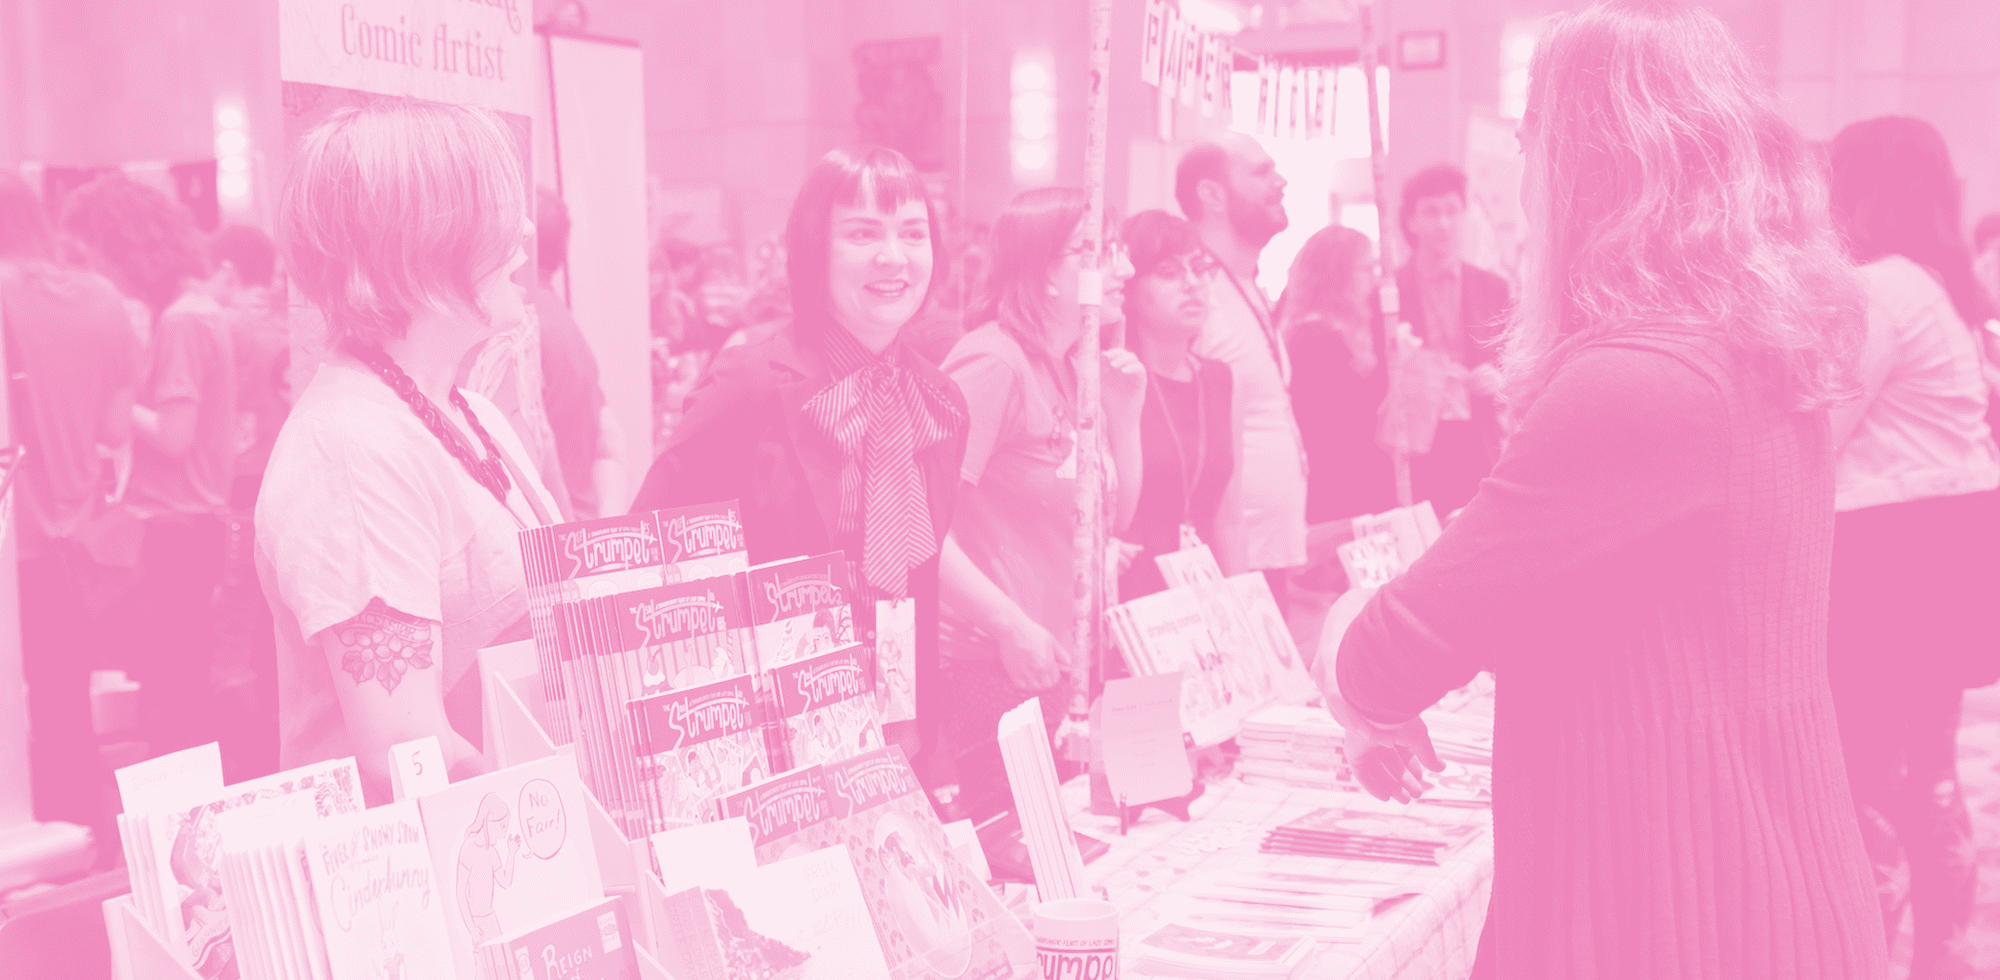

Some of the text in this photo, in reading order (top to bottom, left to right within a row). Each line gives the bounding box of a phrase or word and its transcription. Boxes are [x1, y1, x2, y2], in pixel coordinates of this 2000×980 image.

[341, 2, 421, 68] Comic
[432, 23, 504, 82] Artist
[1145, 12, 1231, 109] PAPER
[564, 520, 651, 580] Strumpet
[667, 508, 738, 564] Strumpet
[635, 589, 715, 648] Strumpet
[765, 564, 835, 623] Strumpet
[797, 653, 859, 715] Strumpet
[668, 685, 745, 750] Strumpet
[411, 750, 423, 776] 5
[834, 751, 907, 818] Strumpet
[525, 809, 561, 838] Fair!
[529, 791, 549, 808] No
[331, 854, 431, 933] Cinderbunny
[811, 882, 843, 903] DIARY
[541, 944, 593, 980] REIGN
